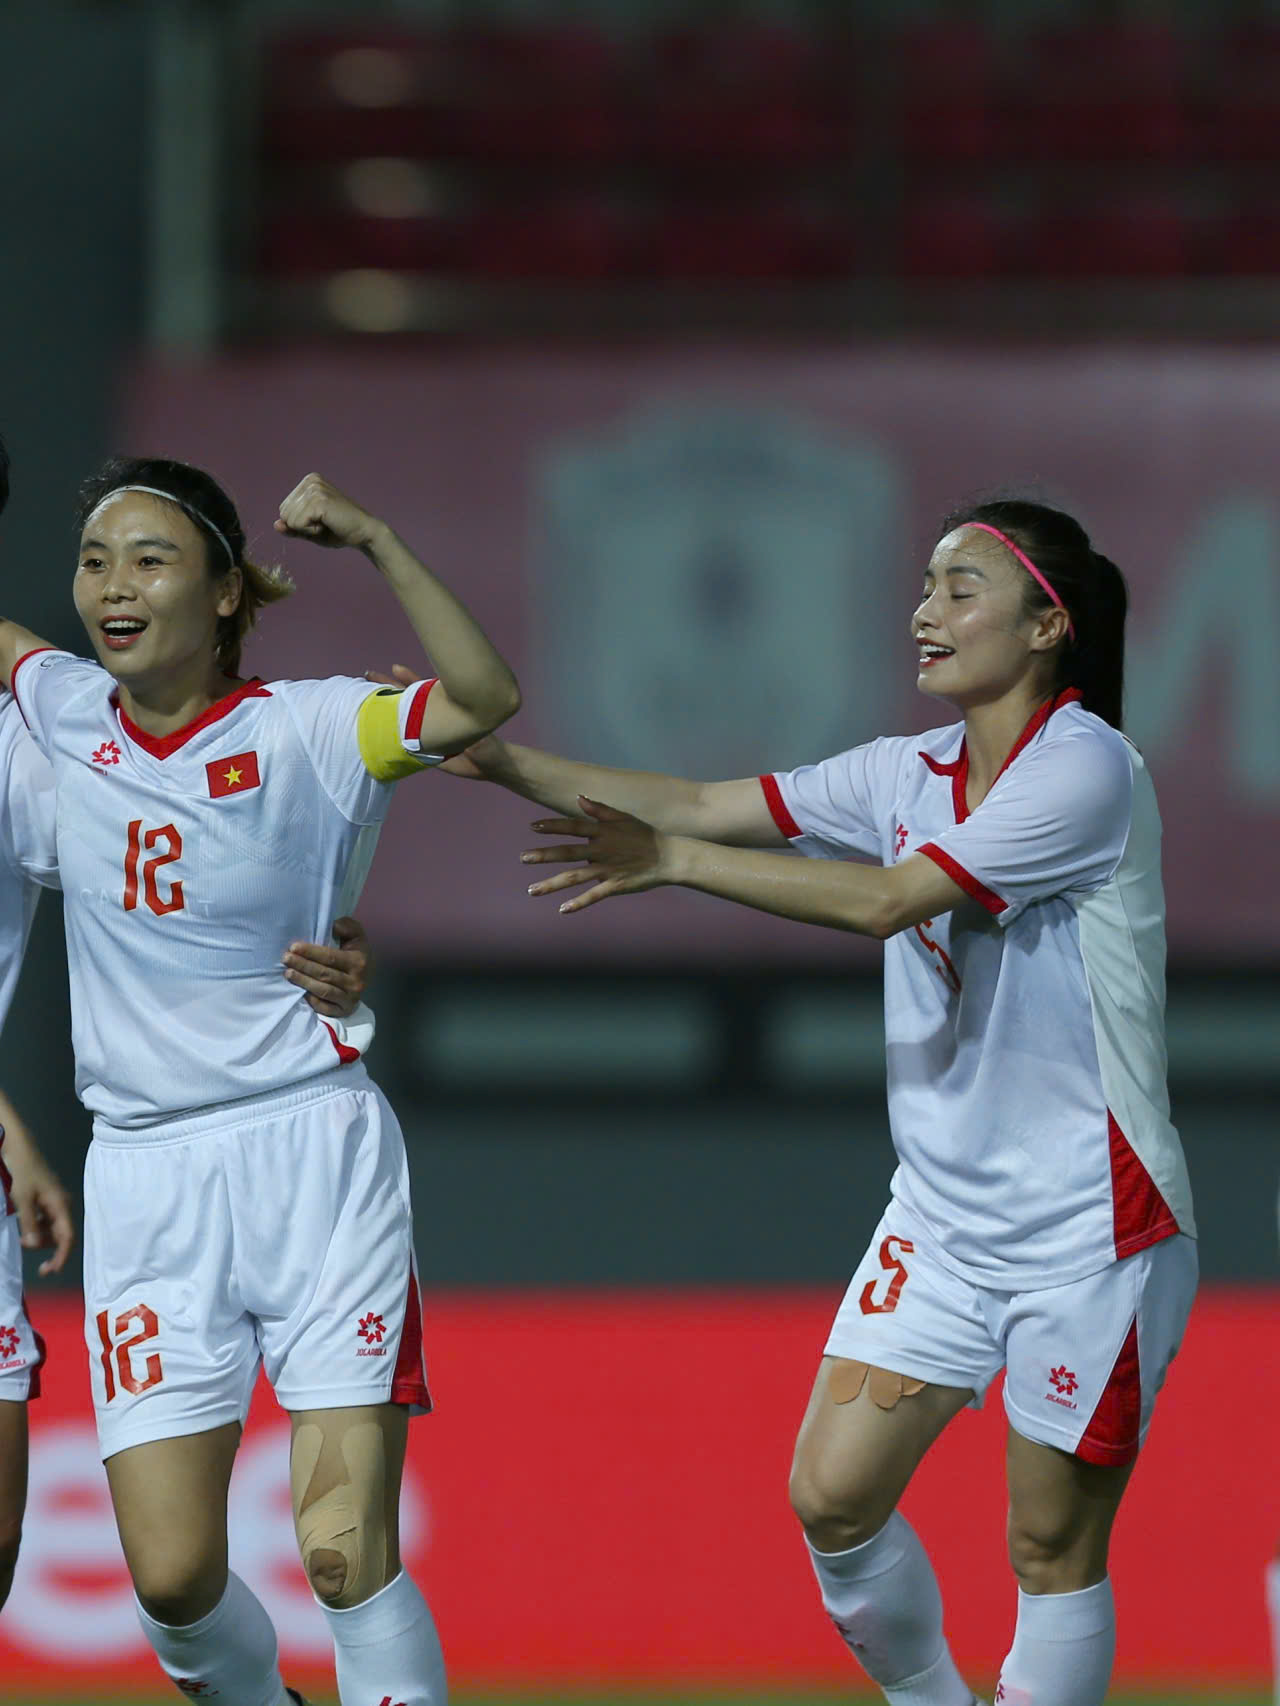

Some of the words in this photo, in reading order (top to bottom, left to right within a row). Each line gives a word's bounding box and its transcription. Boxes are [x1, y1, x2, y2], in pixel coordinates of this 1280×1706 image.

[123, 818, 185, 917] 12
[858, 1234, 914, 1316] 5
[95, 1302, 164, 1405] 12
